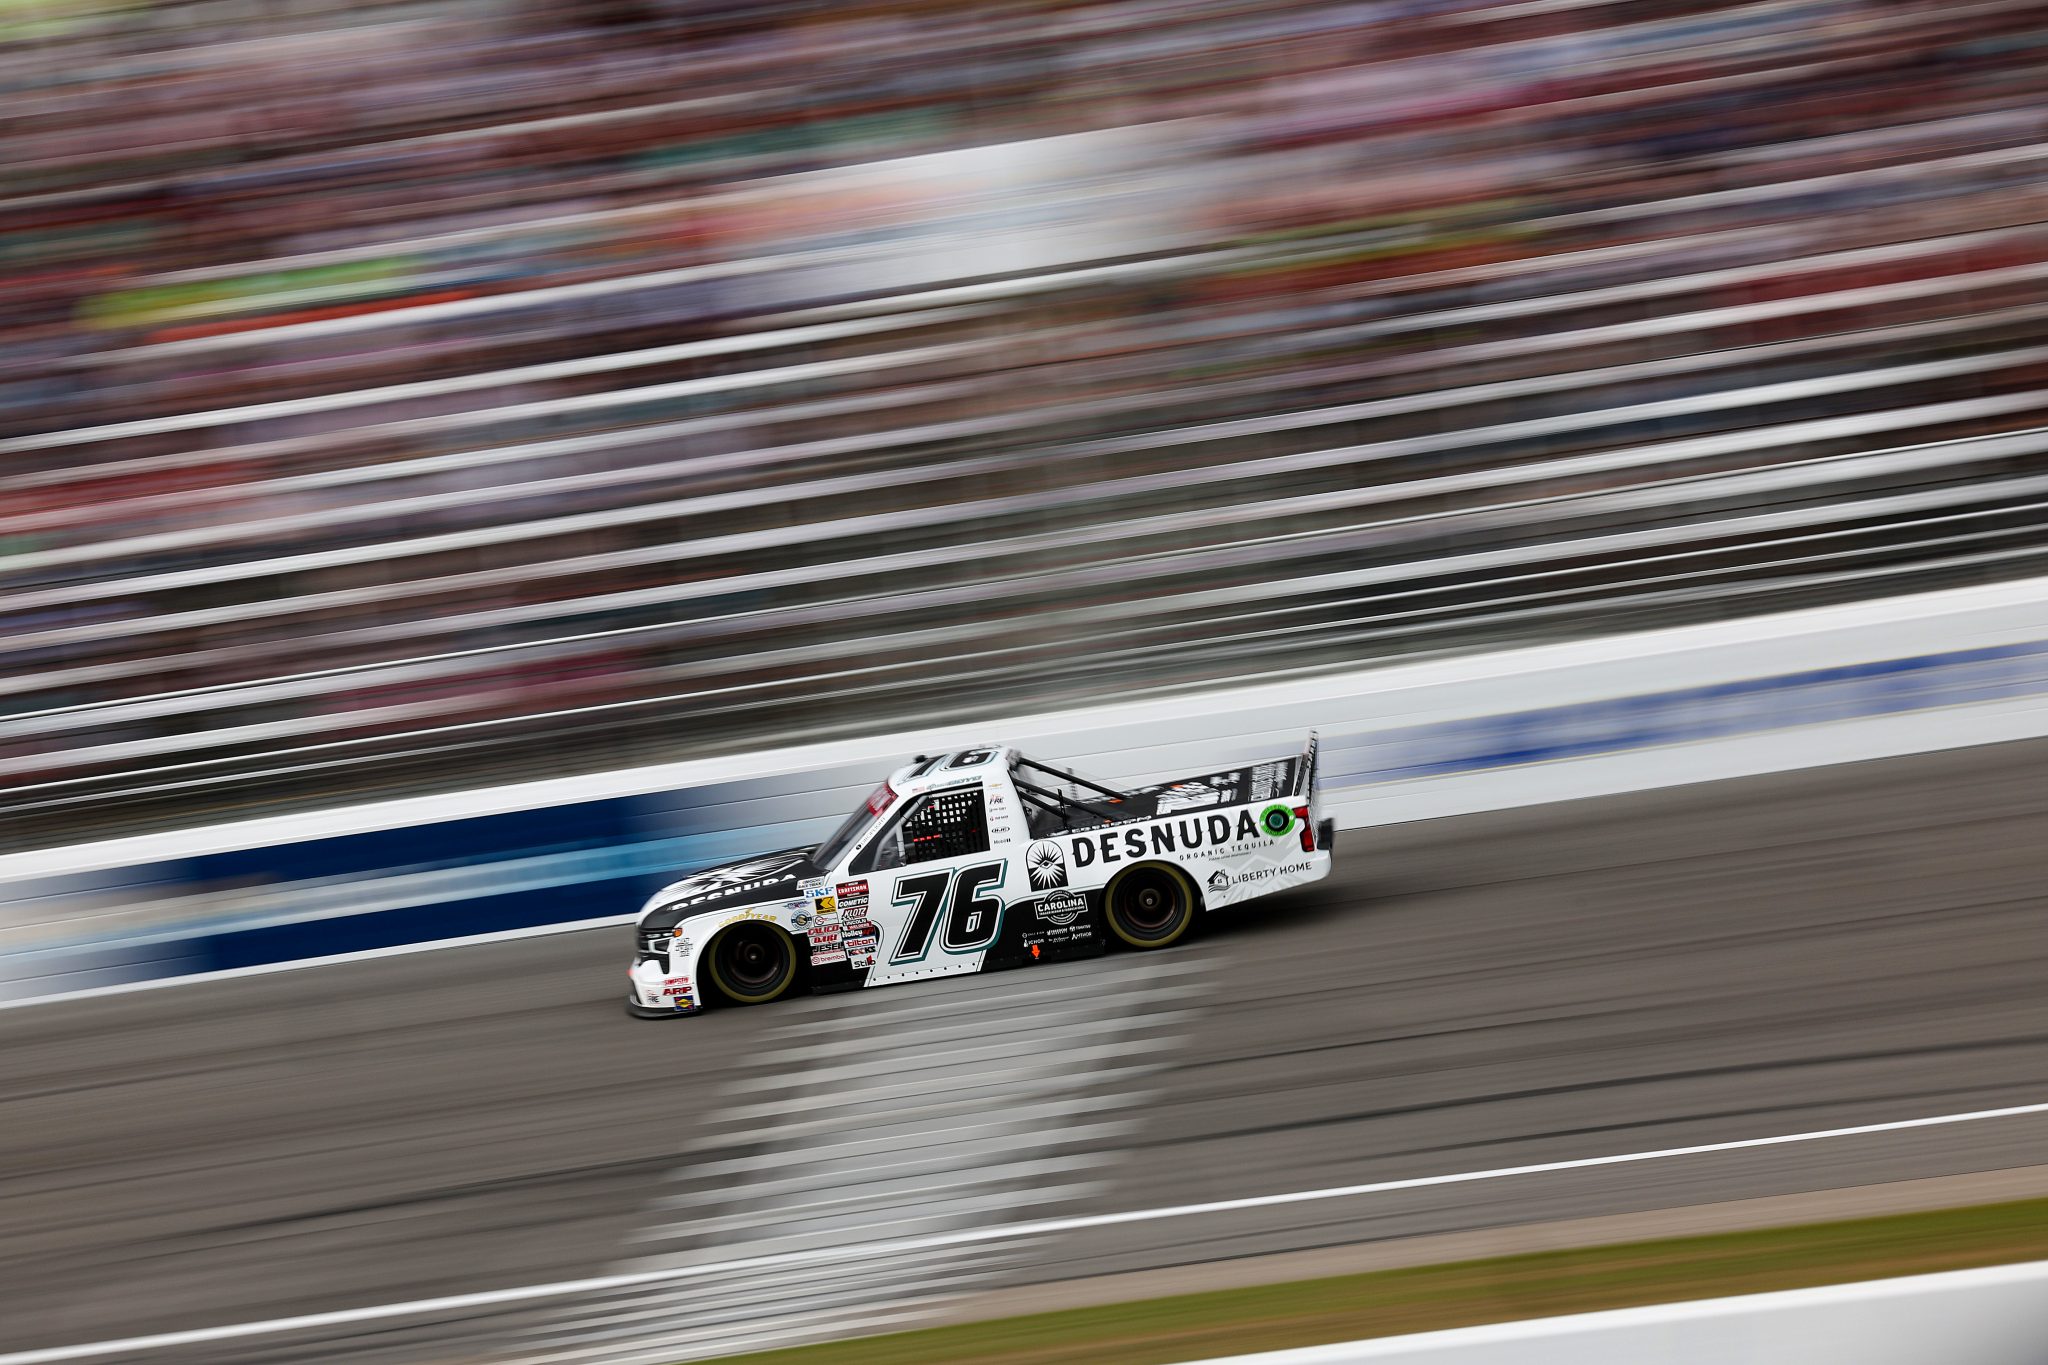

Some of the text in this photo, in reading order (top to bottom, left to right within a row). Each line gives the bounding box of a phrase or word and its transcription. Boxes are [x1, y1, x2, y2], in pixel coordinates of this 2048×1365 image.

[1072, 809, 1260, 868] DESNUDA
[1179, 848, 1225, 861] ORGANIC
[1231, 840, 1275, 852] TEQUILA
[1232, 861, 1313, 885] LIBERTY HOME
[666, 874, 797, 912] DESNUDA
[805, 886, 834, 898] SKF
[1037, 897, 1085, 912] CAROLINA
[719, 908, 777, 928] GOODYEAR
[844, 907, 867, 918] KLOTZ
[888, 858, 1008, 966] 76
[808, 924, 840, 935] CALICO
[813, 941, 845, 952] JESEL
[846, 938, 875, 947] tilton
[820, 954, 845, 962] brembo
[663, 986, 692, 996] ARP
